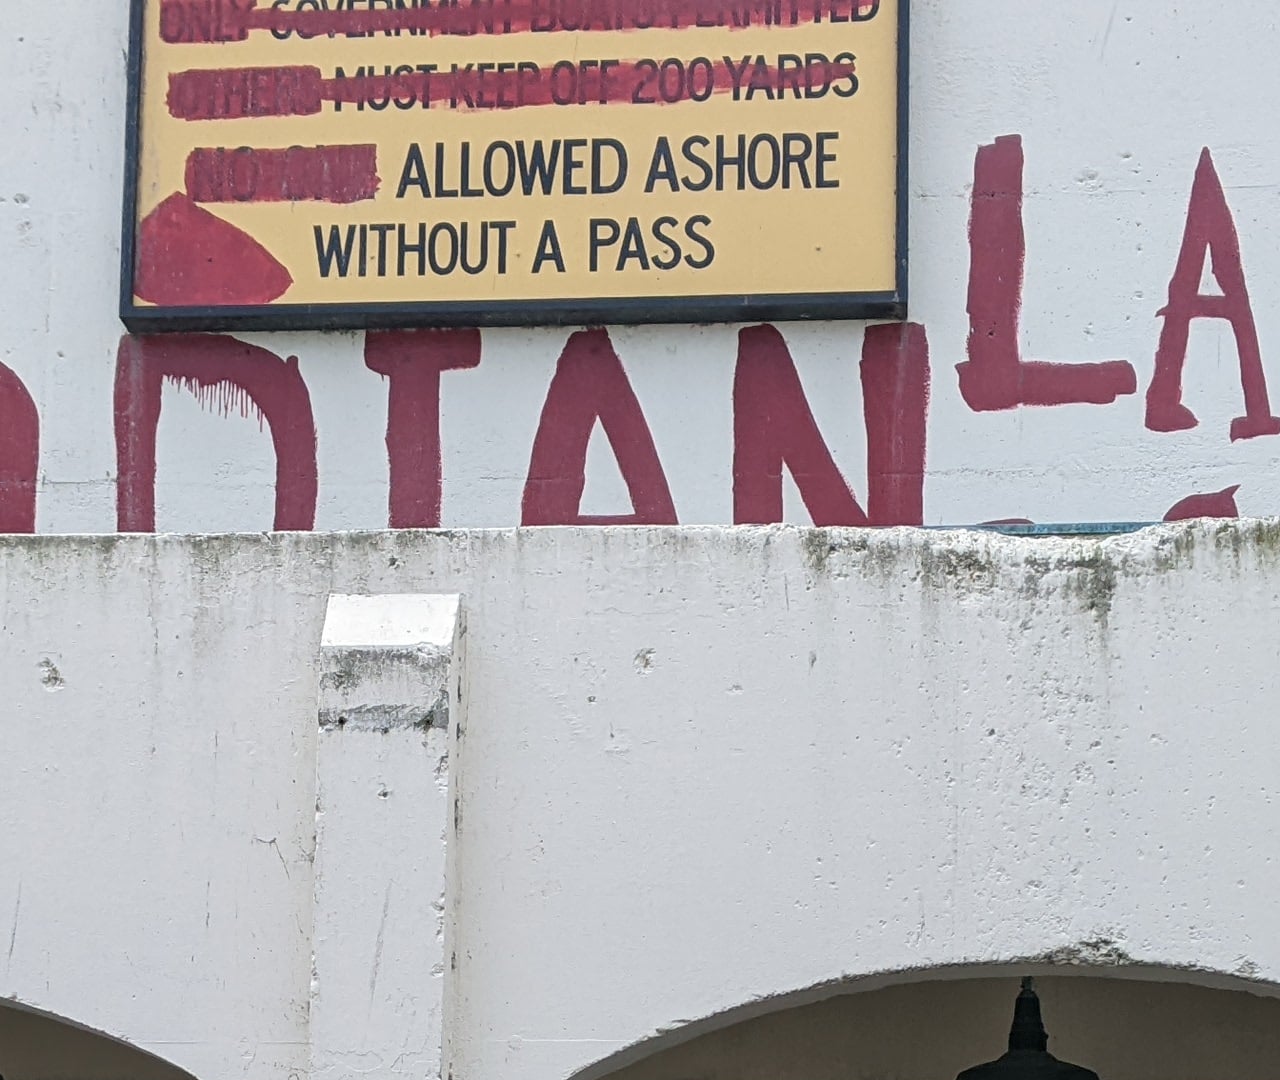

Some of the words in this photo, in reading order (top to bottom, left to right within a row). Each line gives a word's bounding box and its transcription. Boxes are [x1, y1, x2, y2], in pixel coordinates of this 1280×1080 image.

[334, 63, 438, 112] MUST
[451, 61, 542, 110] KEEP
[551, 59, 620, 105] OFF
[631, 56, 715, 104] 200
[722, 51, 859, 102] YARDS
[395, 138, 629, 198] ALLOWED
[644, 131, 840, 193] ASHORE
[313, 220, 516, 278] WITHOUT
[531, 219, 566, 274] A
[589, 214, 715, 272] PASS
